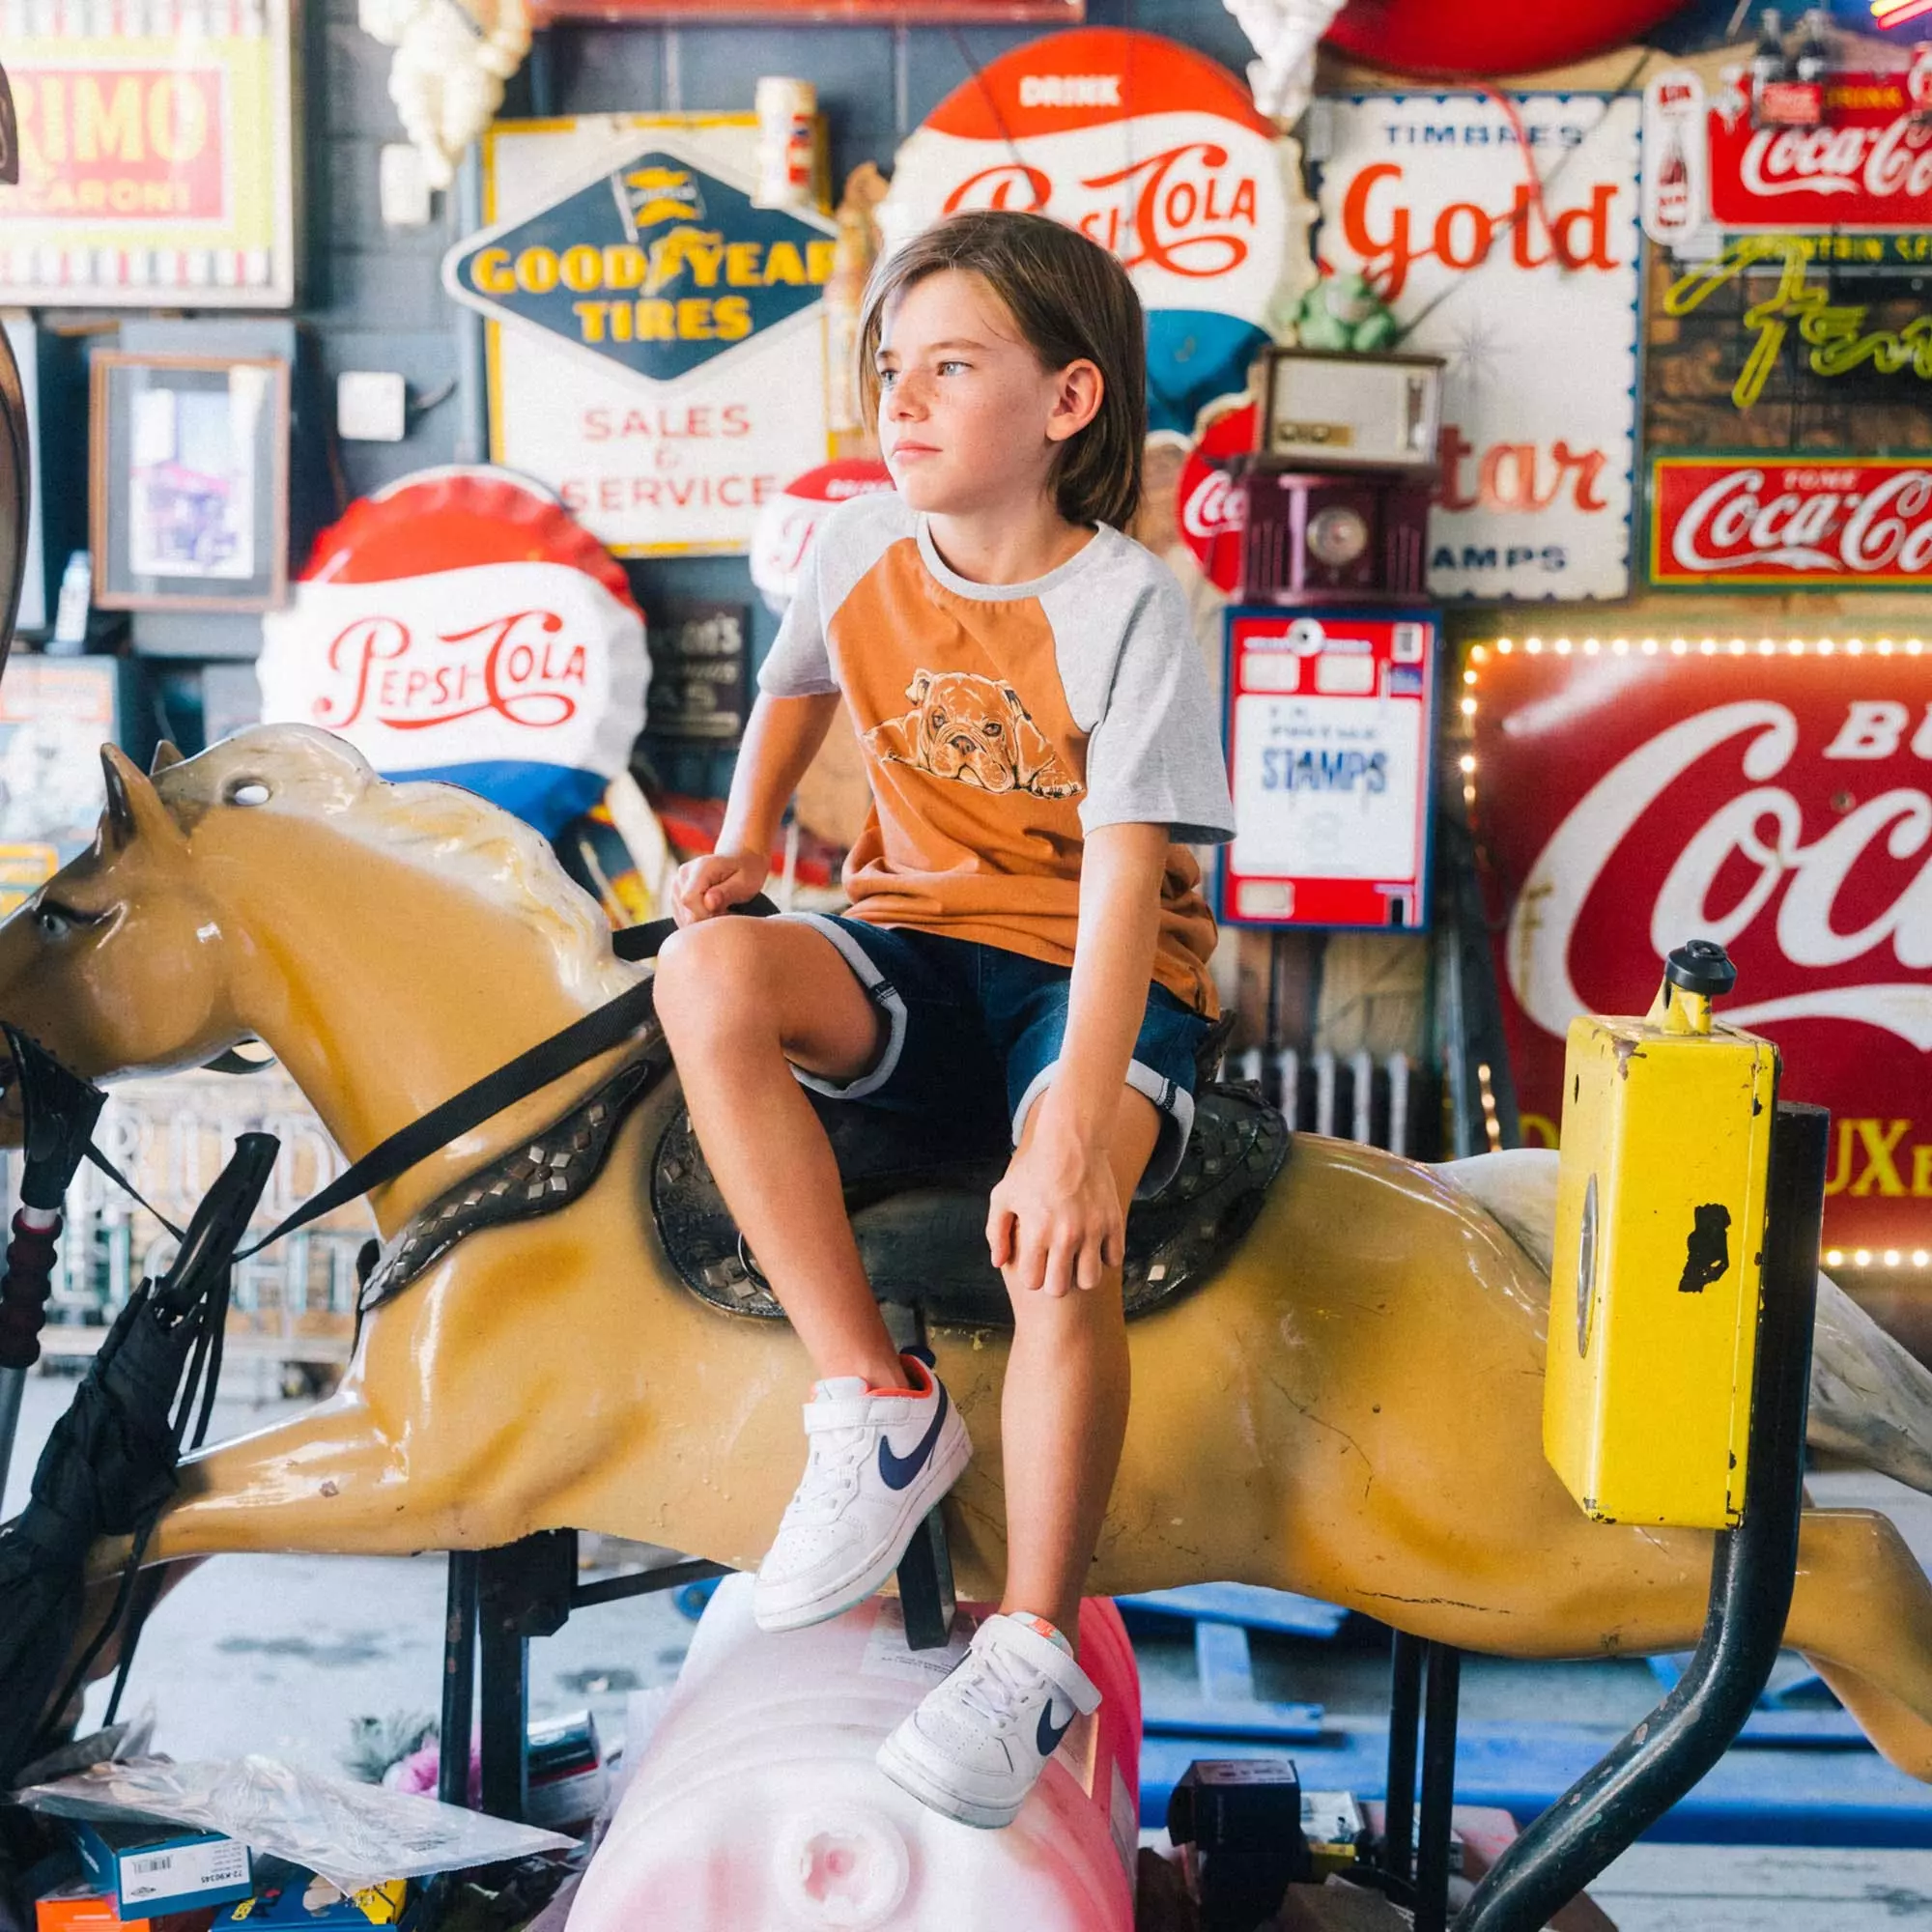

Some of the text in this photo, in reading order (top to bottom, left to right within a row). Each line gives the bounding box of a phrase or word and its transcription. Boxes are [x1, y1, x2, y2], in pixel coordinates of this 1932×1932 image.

[1019, 73, 1122, 108] DRINK
[1342, 162, 1621, 304] Gold
[574, 297, 753, 342] TIRES
[582, 403, 752, 441] SALES
[1434, 423, 1607, 513] tar
[1433, 546, 1567, 573] AMPS
[1260, 745, 1389, 795] STAMPS
